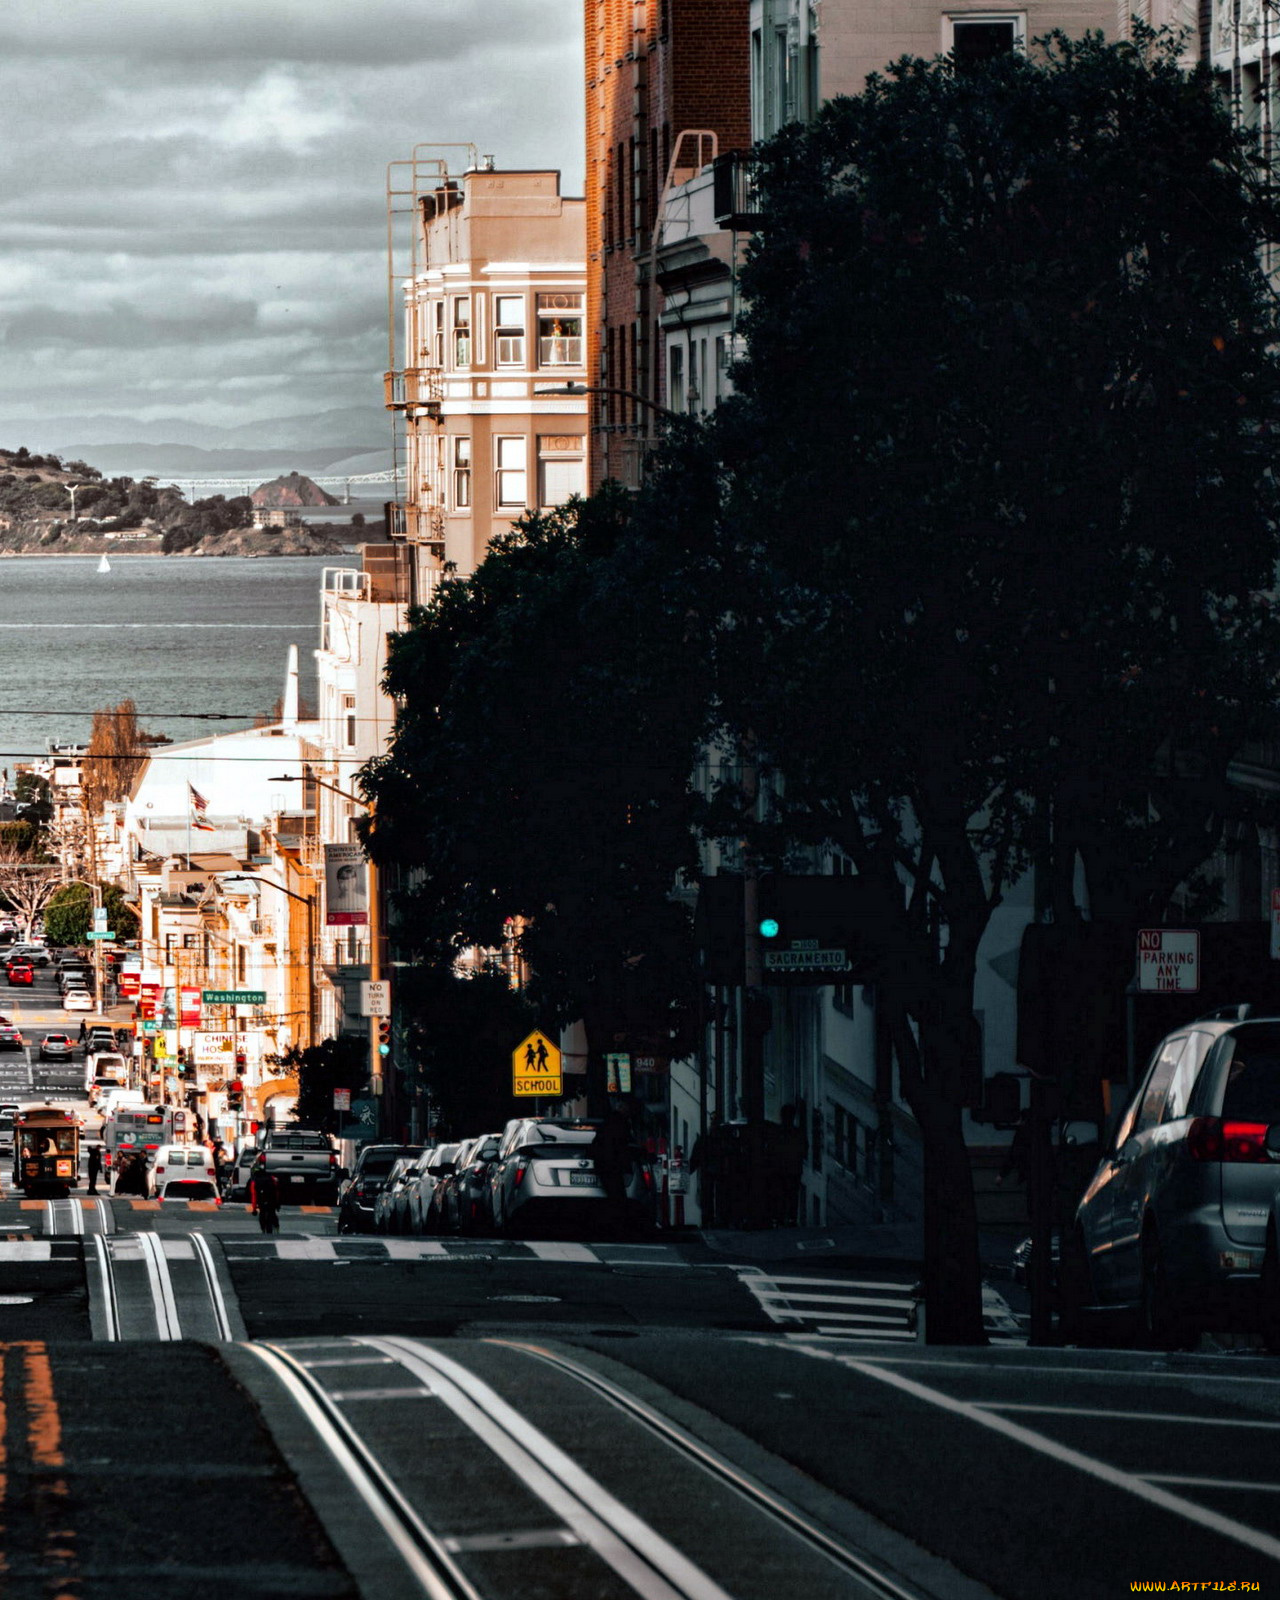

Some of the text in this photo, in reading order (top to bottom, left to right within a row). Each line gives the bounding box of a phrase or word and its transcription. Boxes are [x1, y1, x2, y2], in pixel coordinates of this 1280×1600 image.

[1141, 932, 1160, 949] NO
[769, 952, 842, 965] SACRAMENTO
[1144, 952, 1194, 964] PARKING
[1157, 965, 1181, 977] ANY
[1156, 977, 1182, 990] TIME
[206, 993, 264, 1003] Washington
[202, 1045, 249, 1053] HOSAL
[636, 1057, 655, 1067] 940
[516, 1080, 559, 1091] SCHOOL
